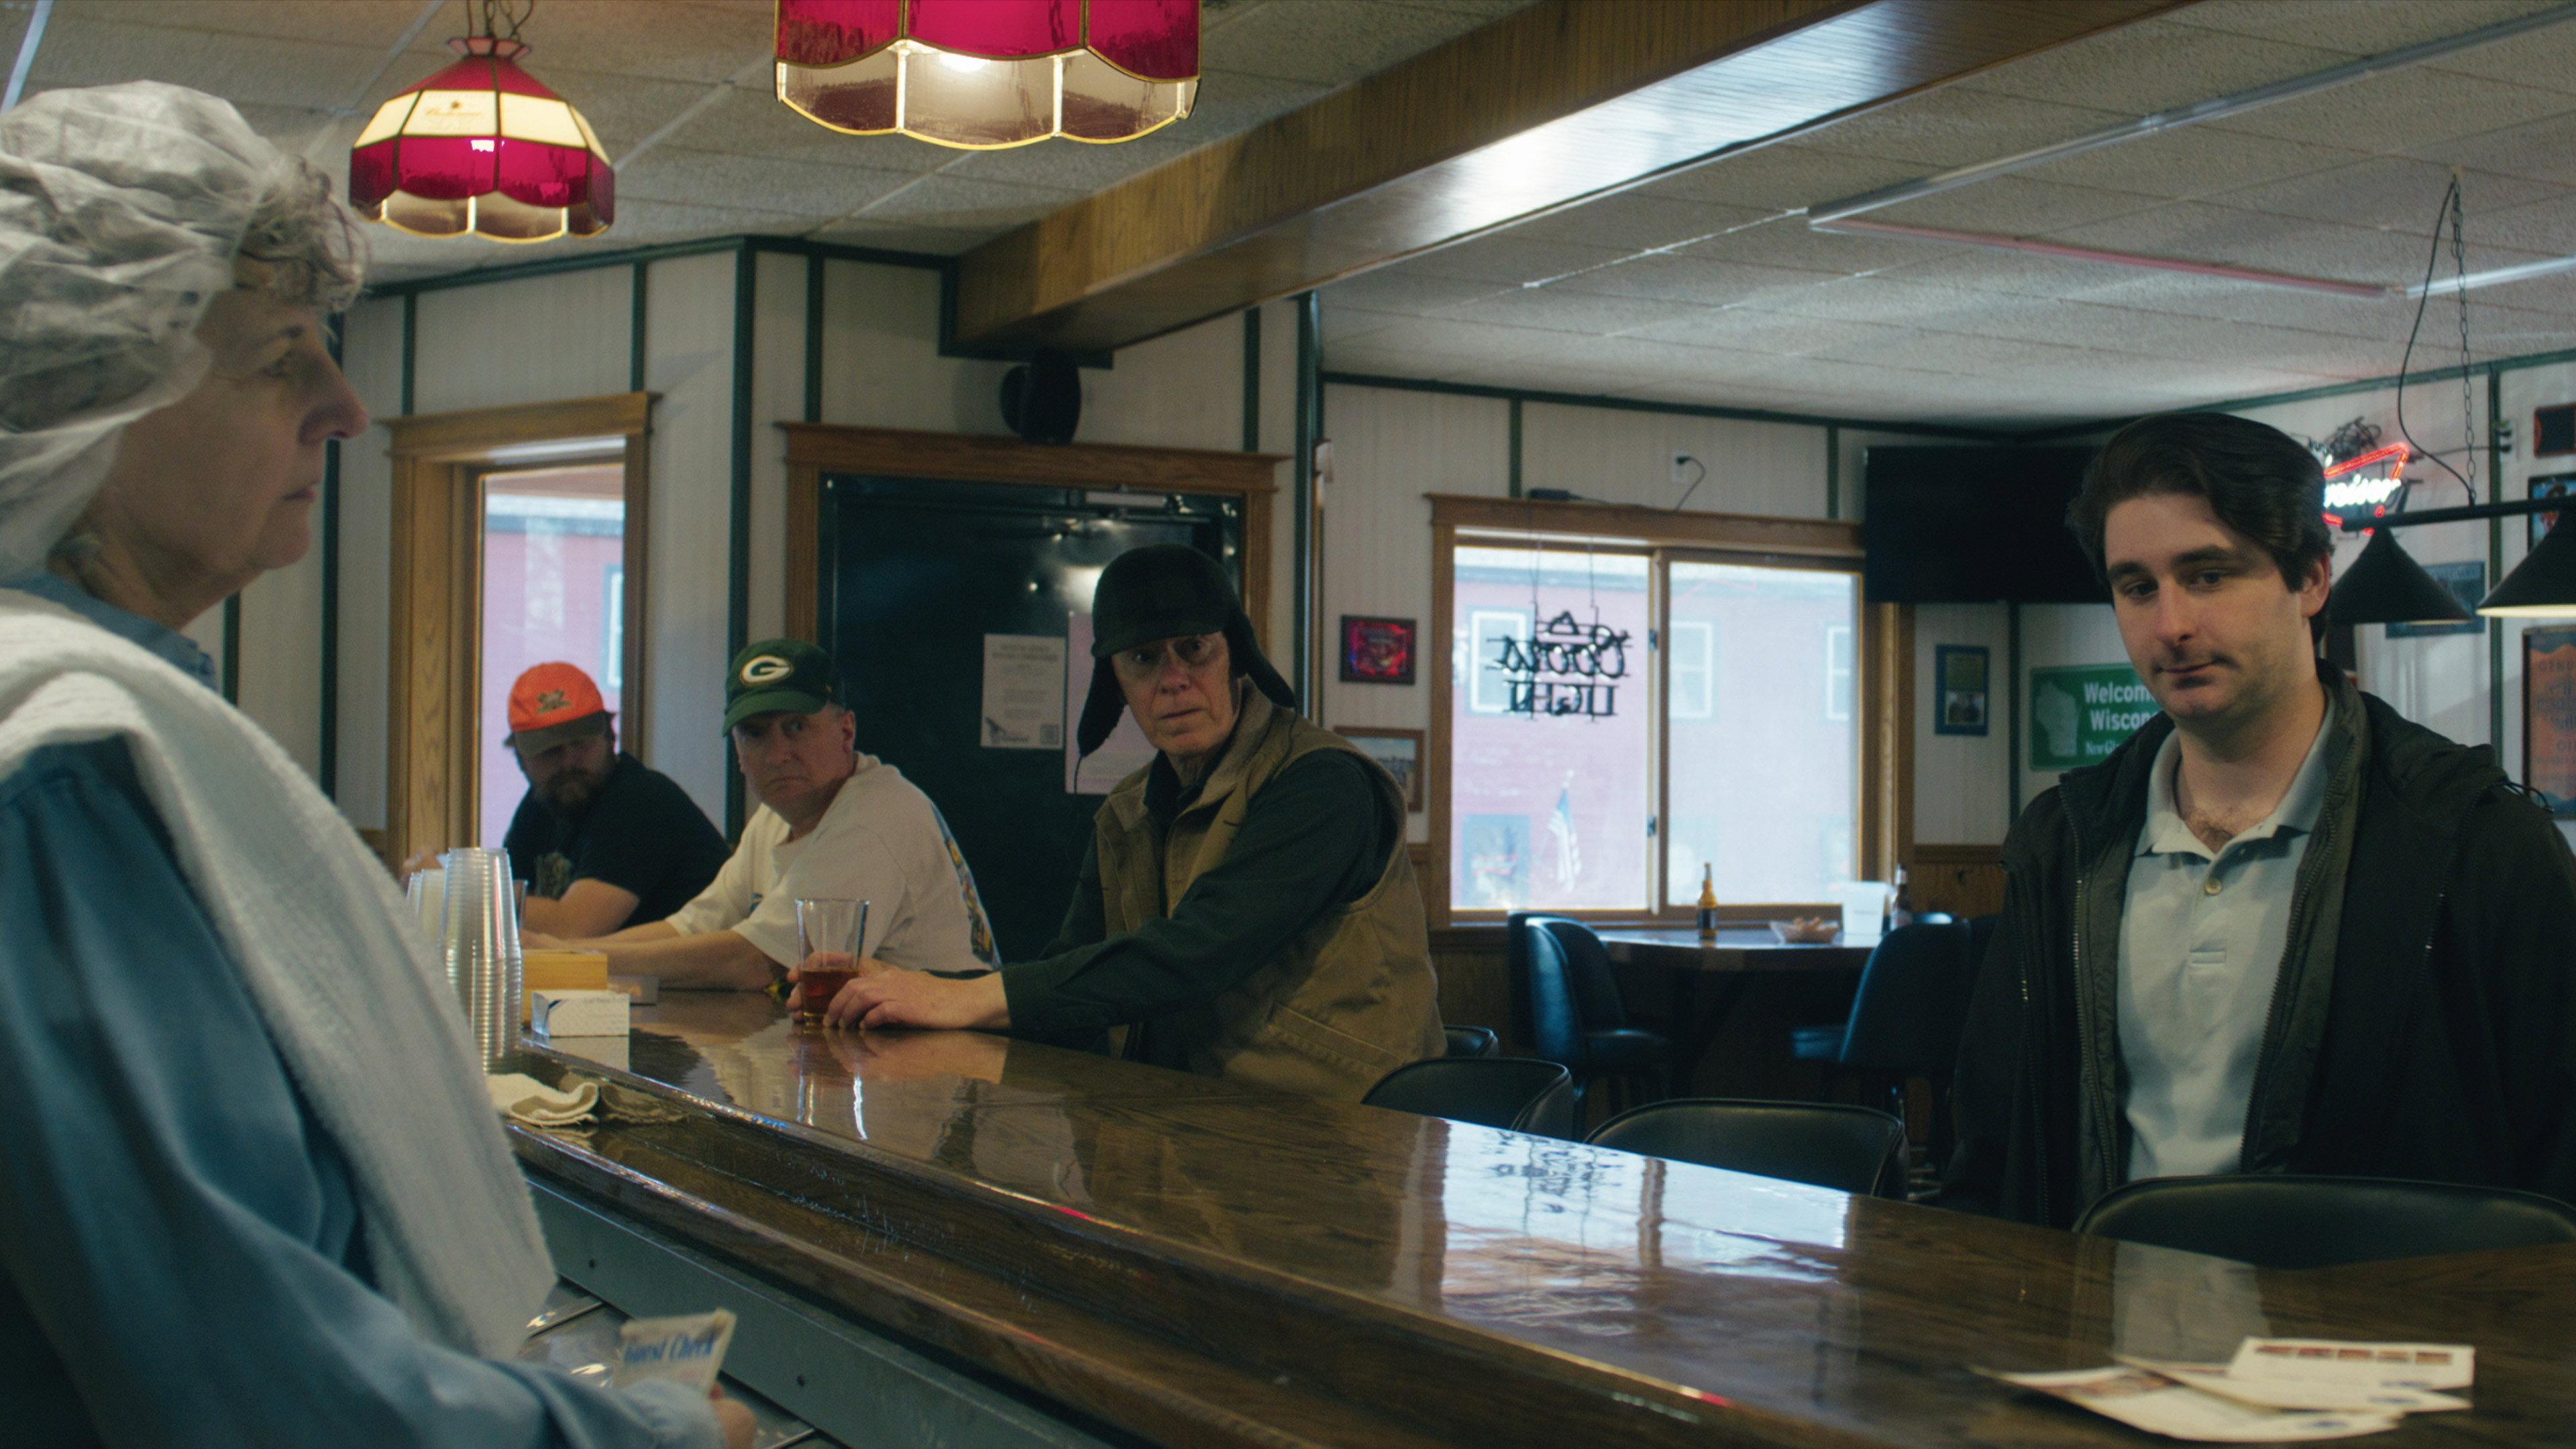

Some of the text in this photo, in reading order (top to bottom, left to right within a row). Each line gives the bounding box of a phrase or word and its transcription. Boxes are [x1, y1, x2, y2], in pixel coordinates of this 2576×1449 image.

[740, 654, 794, 686] G
[2084, 682, 2155, 704] Welcom
[2090, 708, 2157, 731] Wiscon
